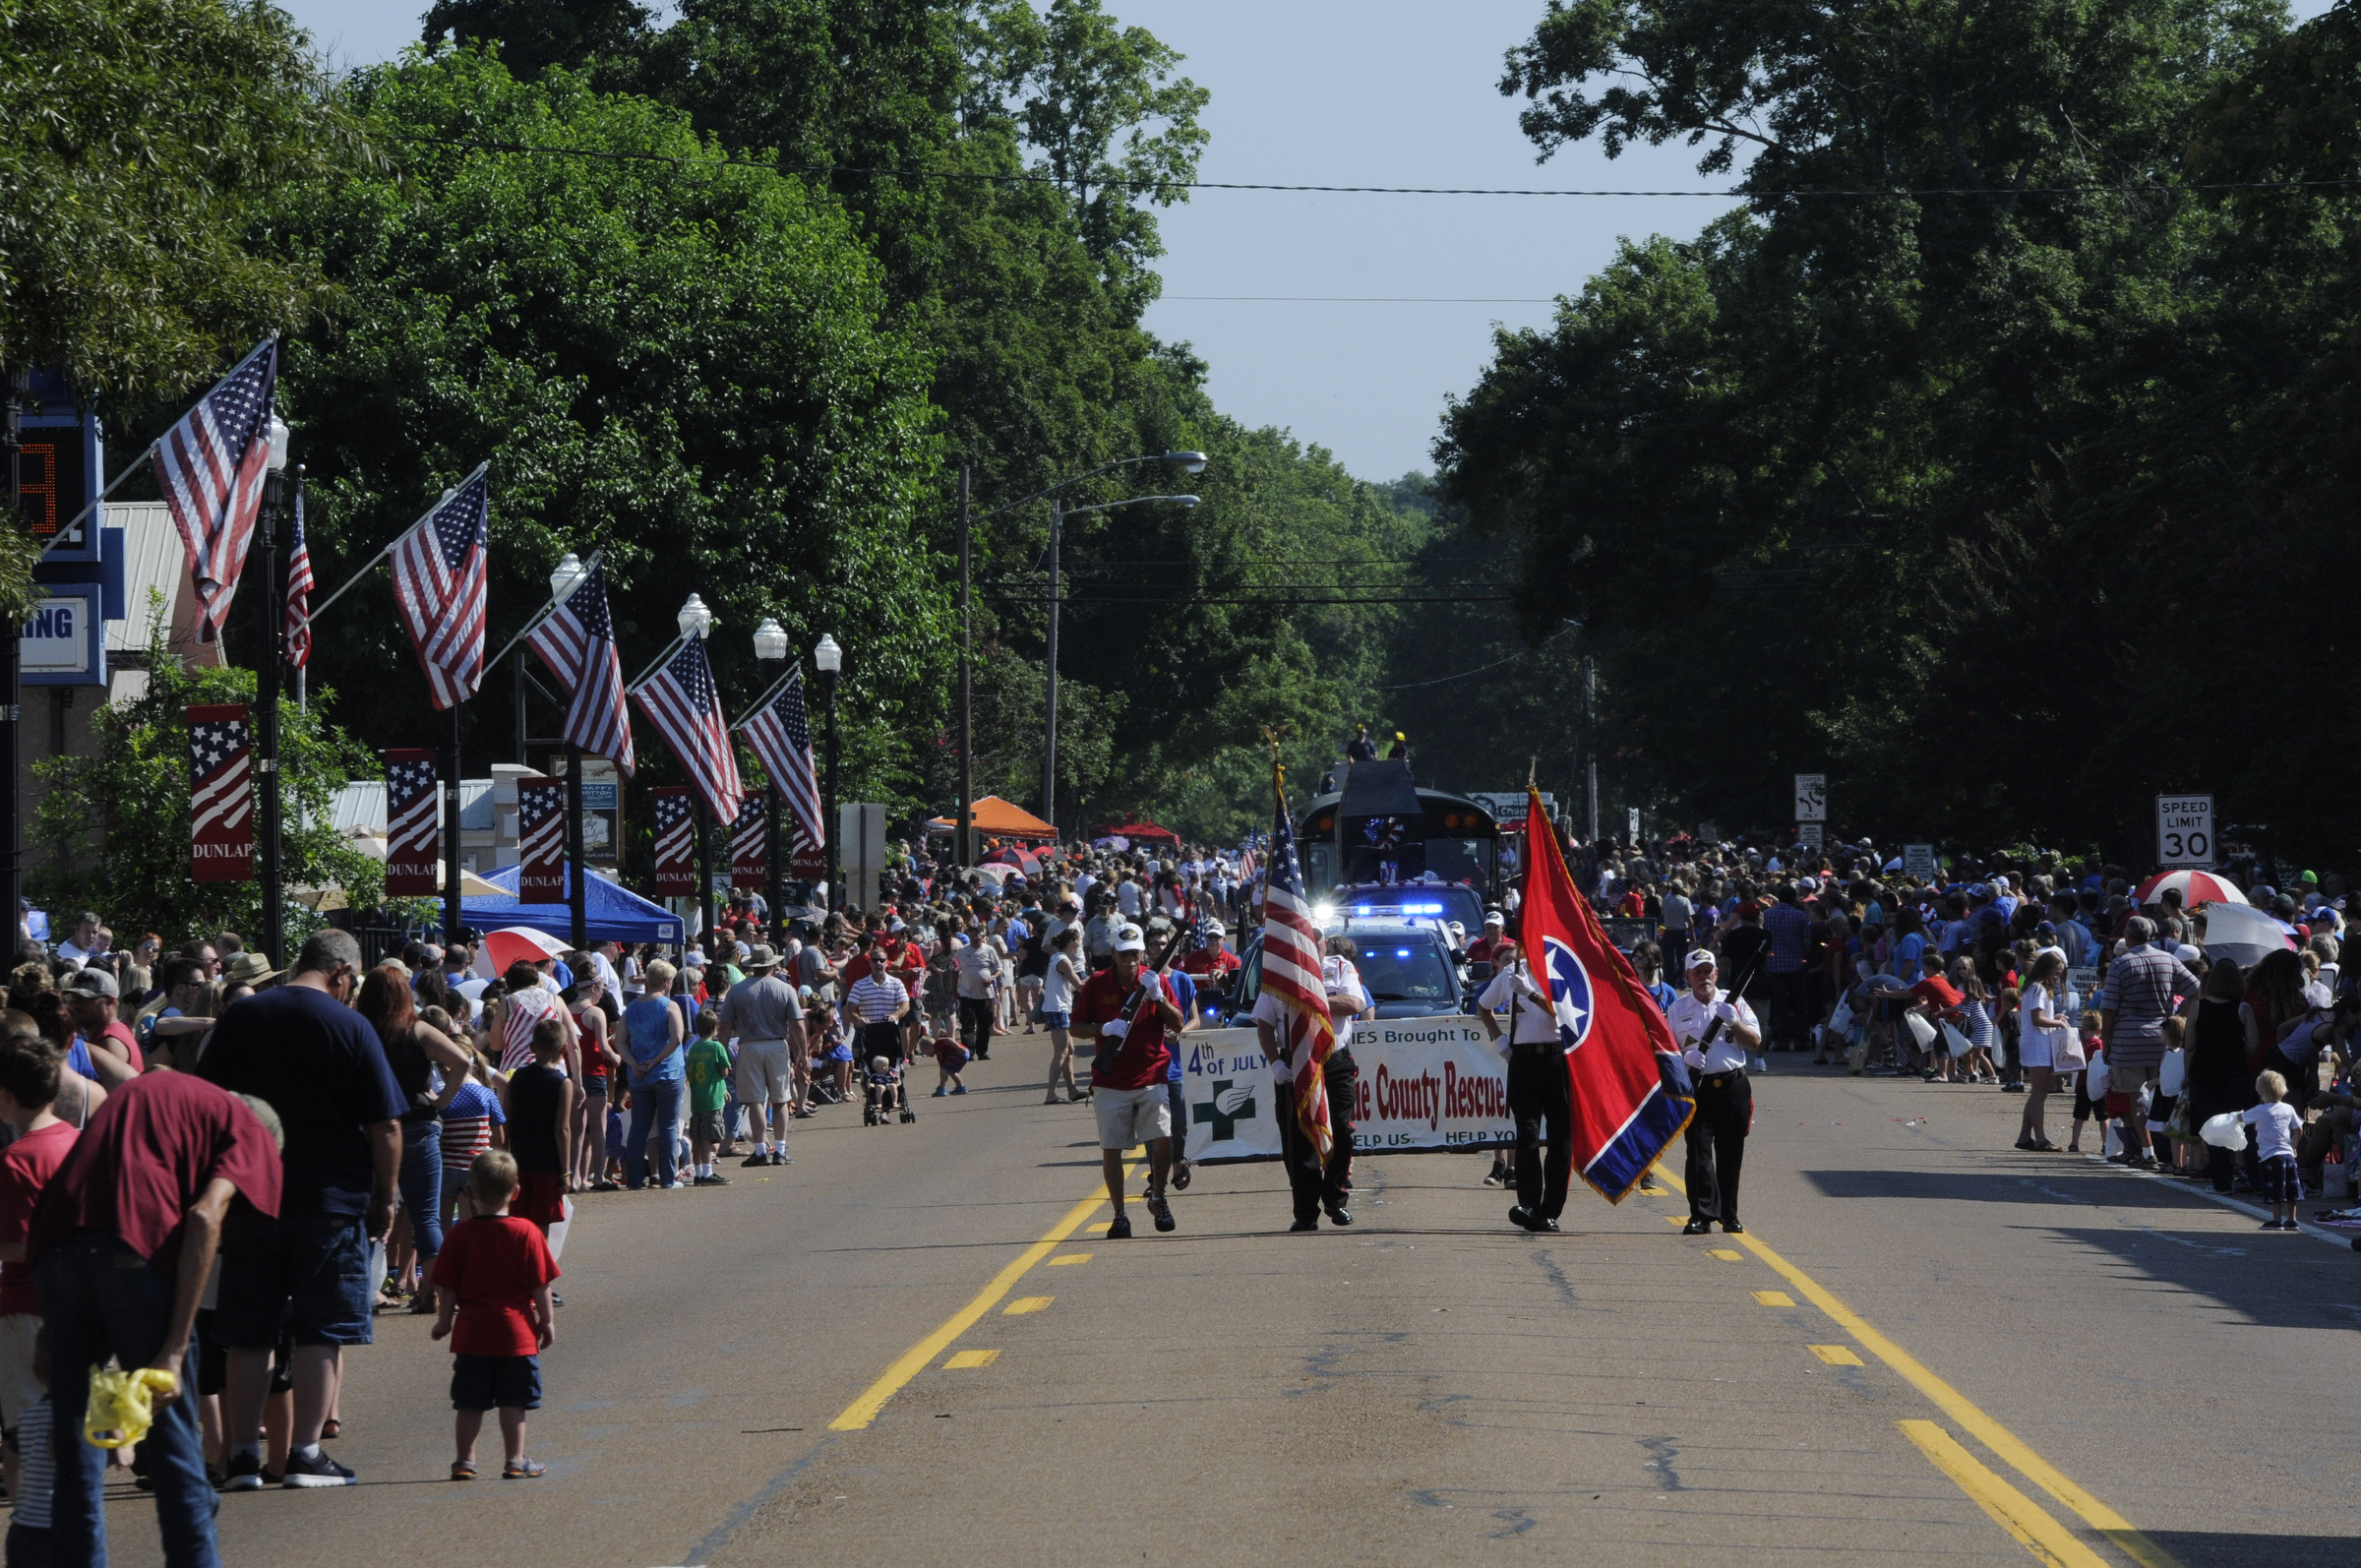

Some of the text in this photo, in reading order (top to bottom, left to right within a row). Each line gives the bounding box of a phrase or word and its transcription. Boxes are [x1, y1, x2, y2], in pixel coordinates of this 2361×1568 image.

[21, 608, 73, 638] ING
[2162, 802, 2209, 813] SPEED
[2167, 817, 2203, 827] LIMIT
[193, 843, 253, 859] DUNLAP
[2165, 832, 2208, 858] 30
[387, 864, 437, 875] DUNLAP
[656, 872, 695, 882] DUNLAP
[731, 866, 765, 875] DUNLAP
[520, 875, 564, 886] DUNLAP
[1385, 1029, 1454, 1044] Brought
[1462, 1029, 1481, 1041] To
[1187, 1043, 1215, 1076] 4th
[1207, 1055, 1267, 1075] of JULY
[1376, 1063, 1440, 1131] County
[1444, 1060, 1505, 1118] Rescue
[1353, 1134, 1382, 1146] ELP
[1445, 1131, 1486, 1143] HELP
[1494, 1130, 1516, 1141] YO
